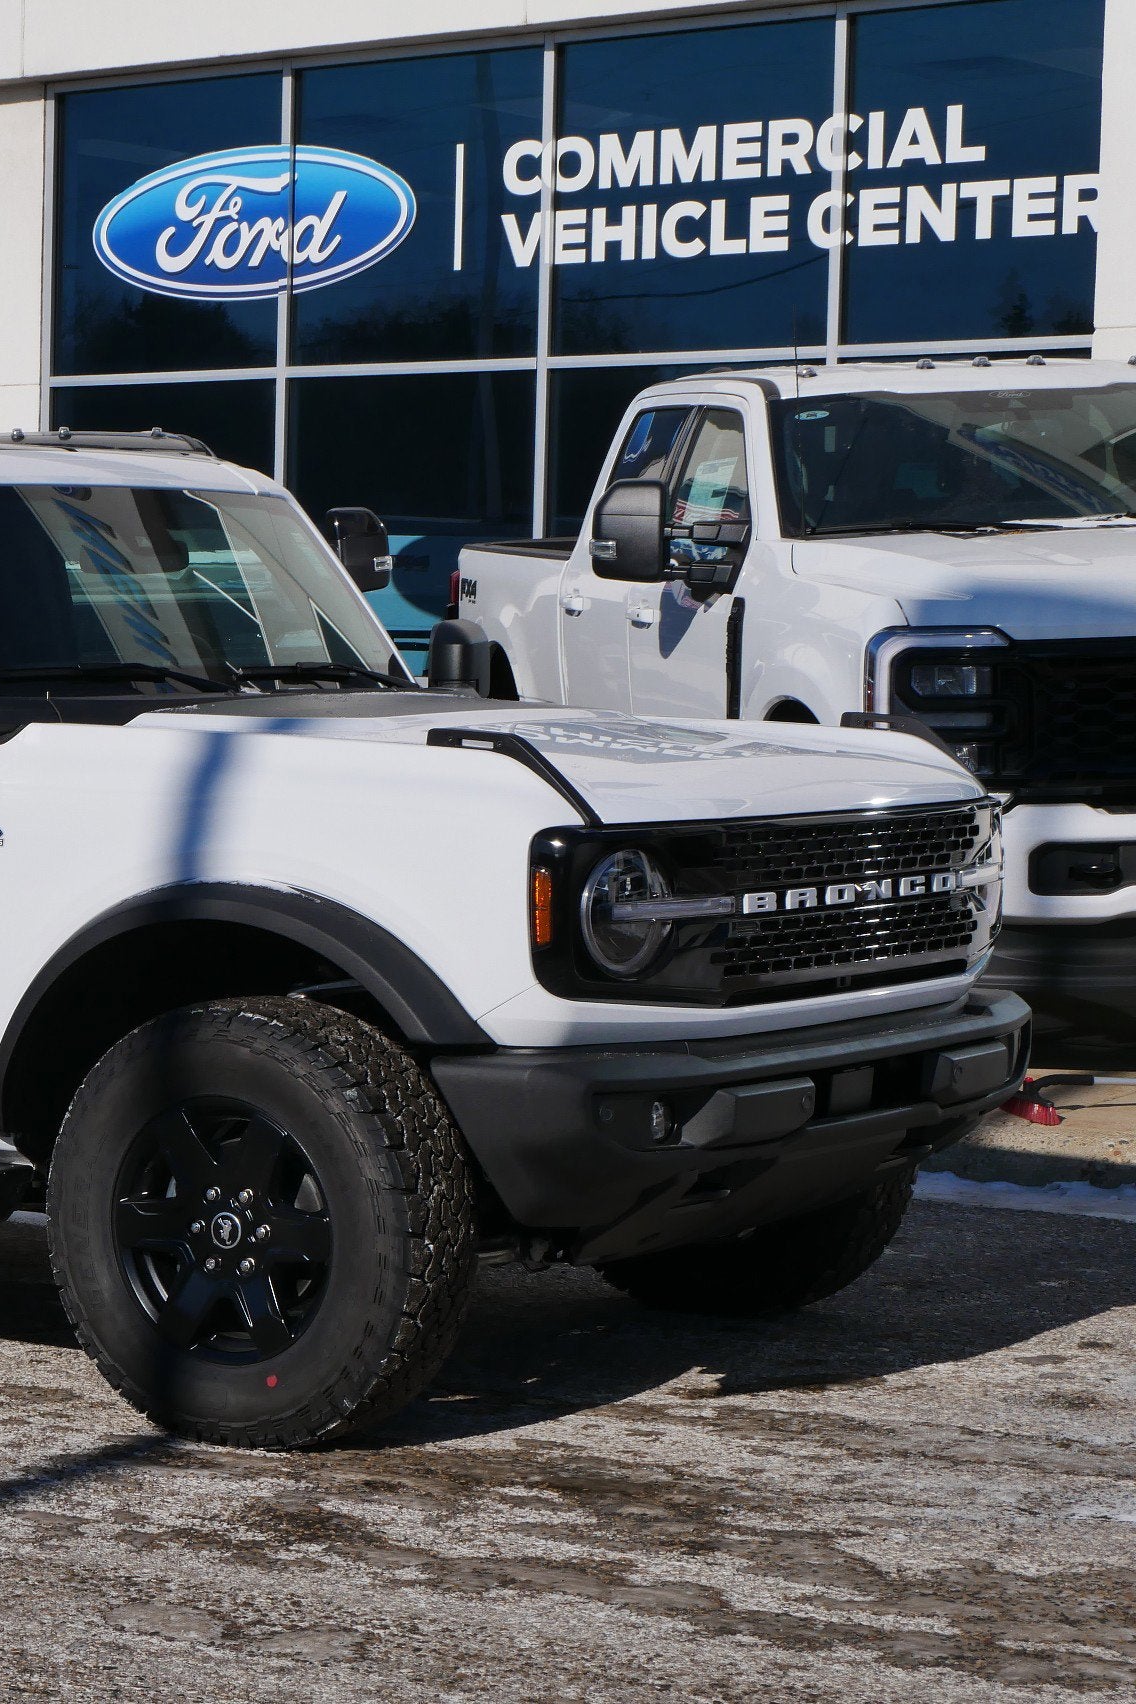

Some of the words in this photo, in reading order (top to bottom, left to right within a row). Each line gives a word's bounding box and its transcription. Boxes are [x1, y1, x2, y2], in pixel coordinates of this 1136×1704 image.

[502, 104, 986, 196] COMMERCIAL
[155, 172, 348, 274] Ford
[500, 194, 790, 268] VEHICLE
[806, 173, 1100, 250] CENTER
[742, 873, 956, 915] BRONCO
